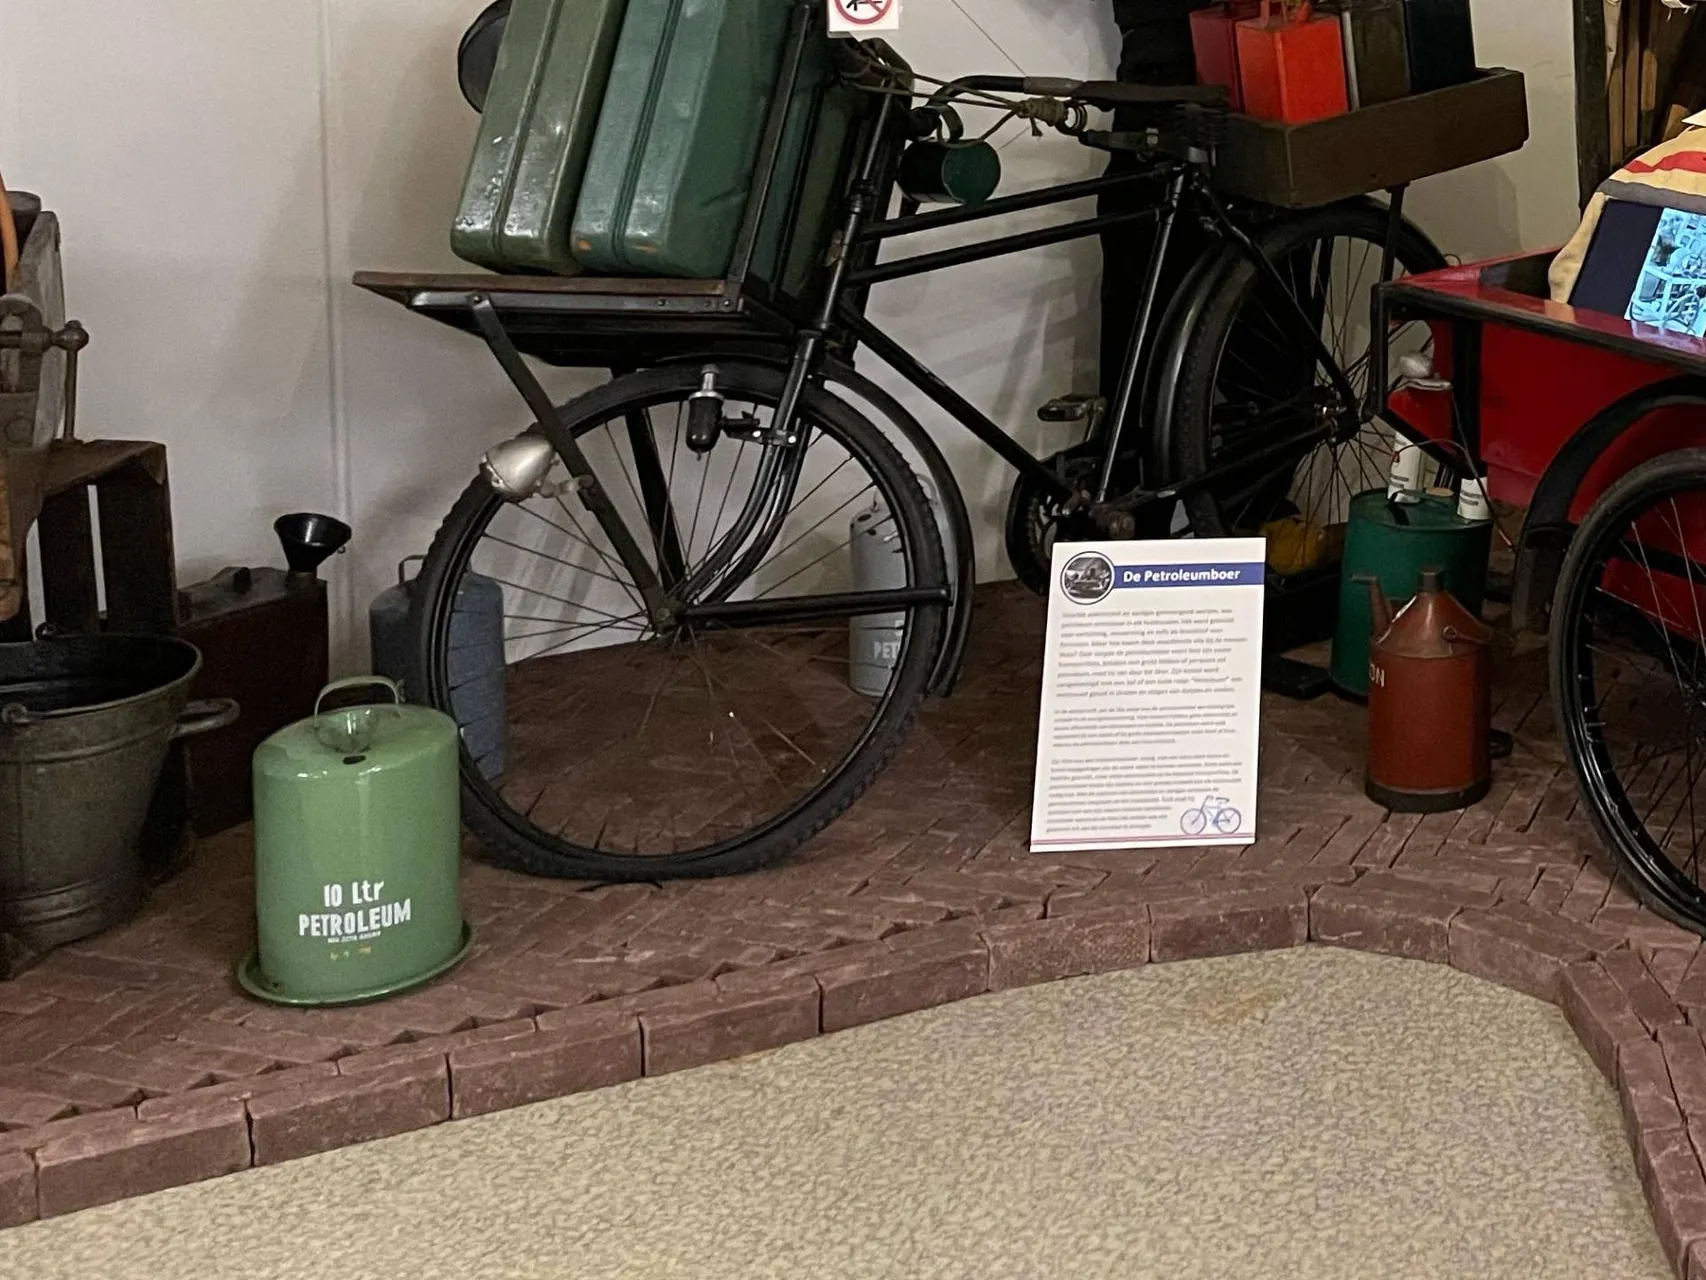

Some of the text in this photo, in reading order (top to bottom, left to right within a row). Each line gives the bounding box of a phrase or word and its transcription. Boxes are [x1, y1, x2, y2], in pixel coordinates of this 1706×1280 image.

[1123, 568, 1241, 583] De Petroleumboer
[323, 879, 384, 907] 10 Ltr
[298, 898, 411, 936] PETROLEUM
